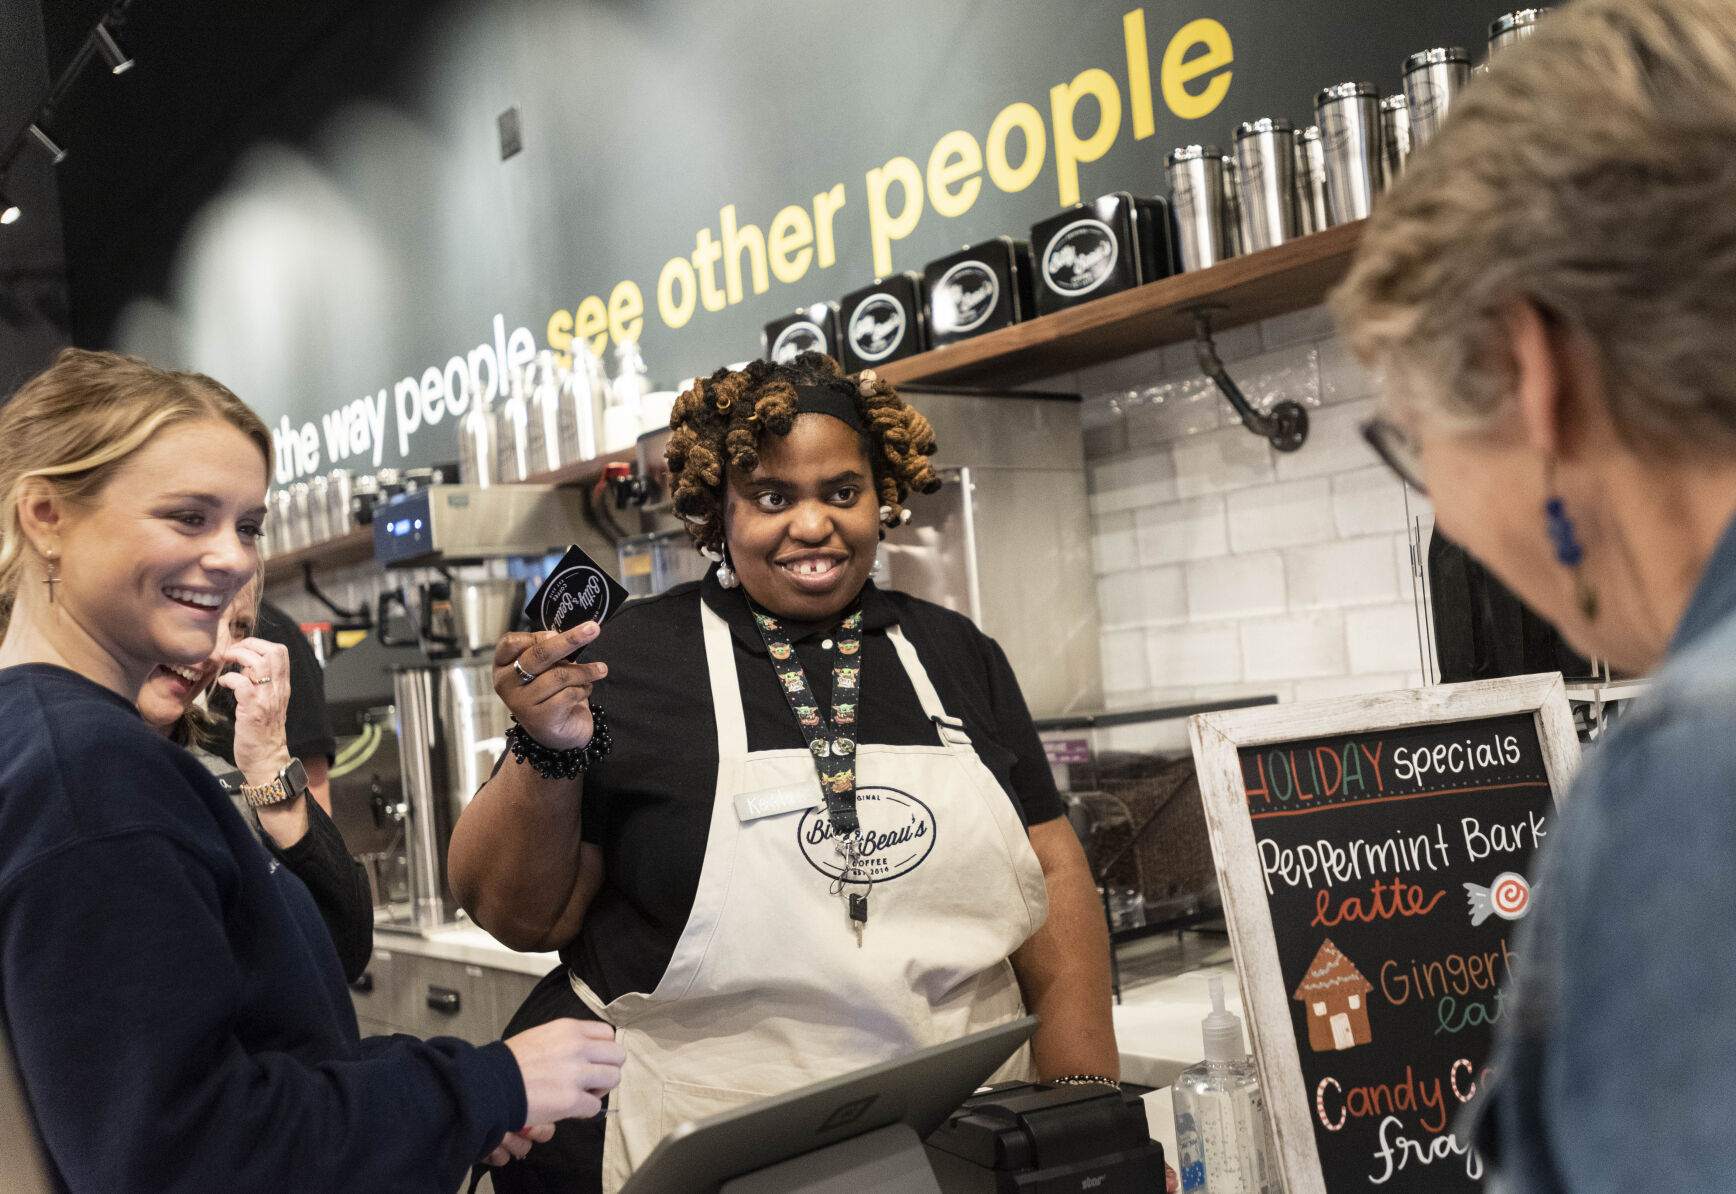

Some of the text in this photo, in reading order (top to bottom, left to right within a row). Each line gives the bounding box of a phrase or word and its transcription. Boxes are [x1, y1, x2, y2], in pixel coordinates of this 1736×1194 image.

[273, 414, 320, 484] the
[322, 388, 387, 467] way
[394, 313, 536, 457] people
[547, 280, 644, 369] see
[657, 183, 846, 329] other
[866, 8, 1234, 278] people
[1240, 740, 1384, 805] HOLIDAY
[857, 794, 881, 802] GINAL
[858, 812, 928, 857] Beau's
[1461, 811, 1548, 861] Bark
[852, 858, 888, 867] COFFEE
[1310, 876, 1447, 927] latte
[1433, 988, 1509, 1036] lat
[1316, 1064, 1447, 1133] Candy
